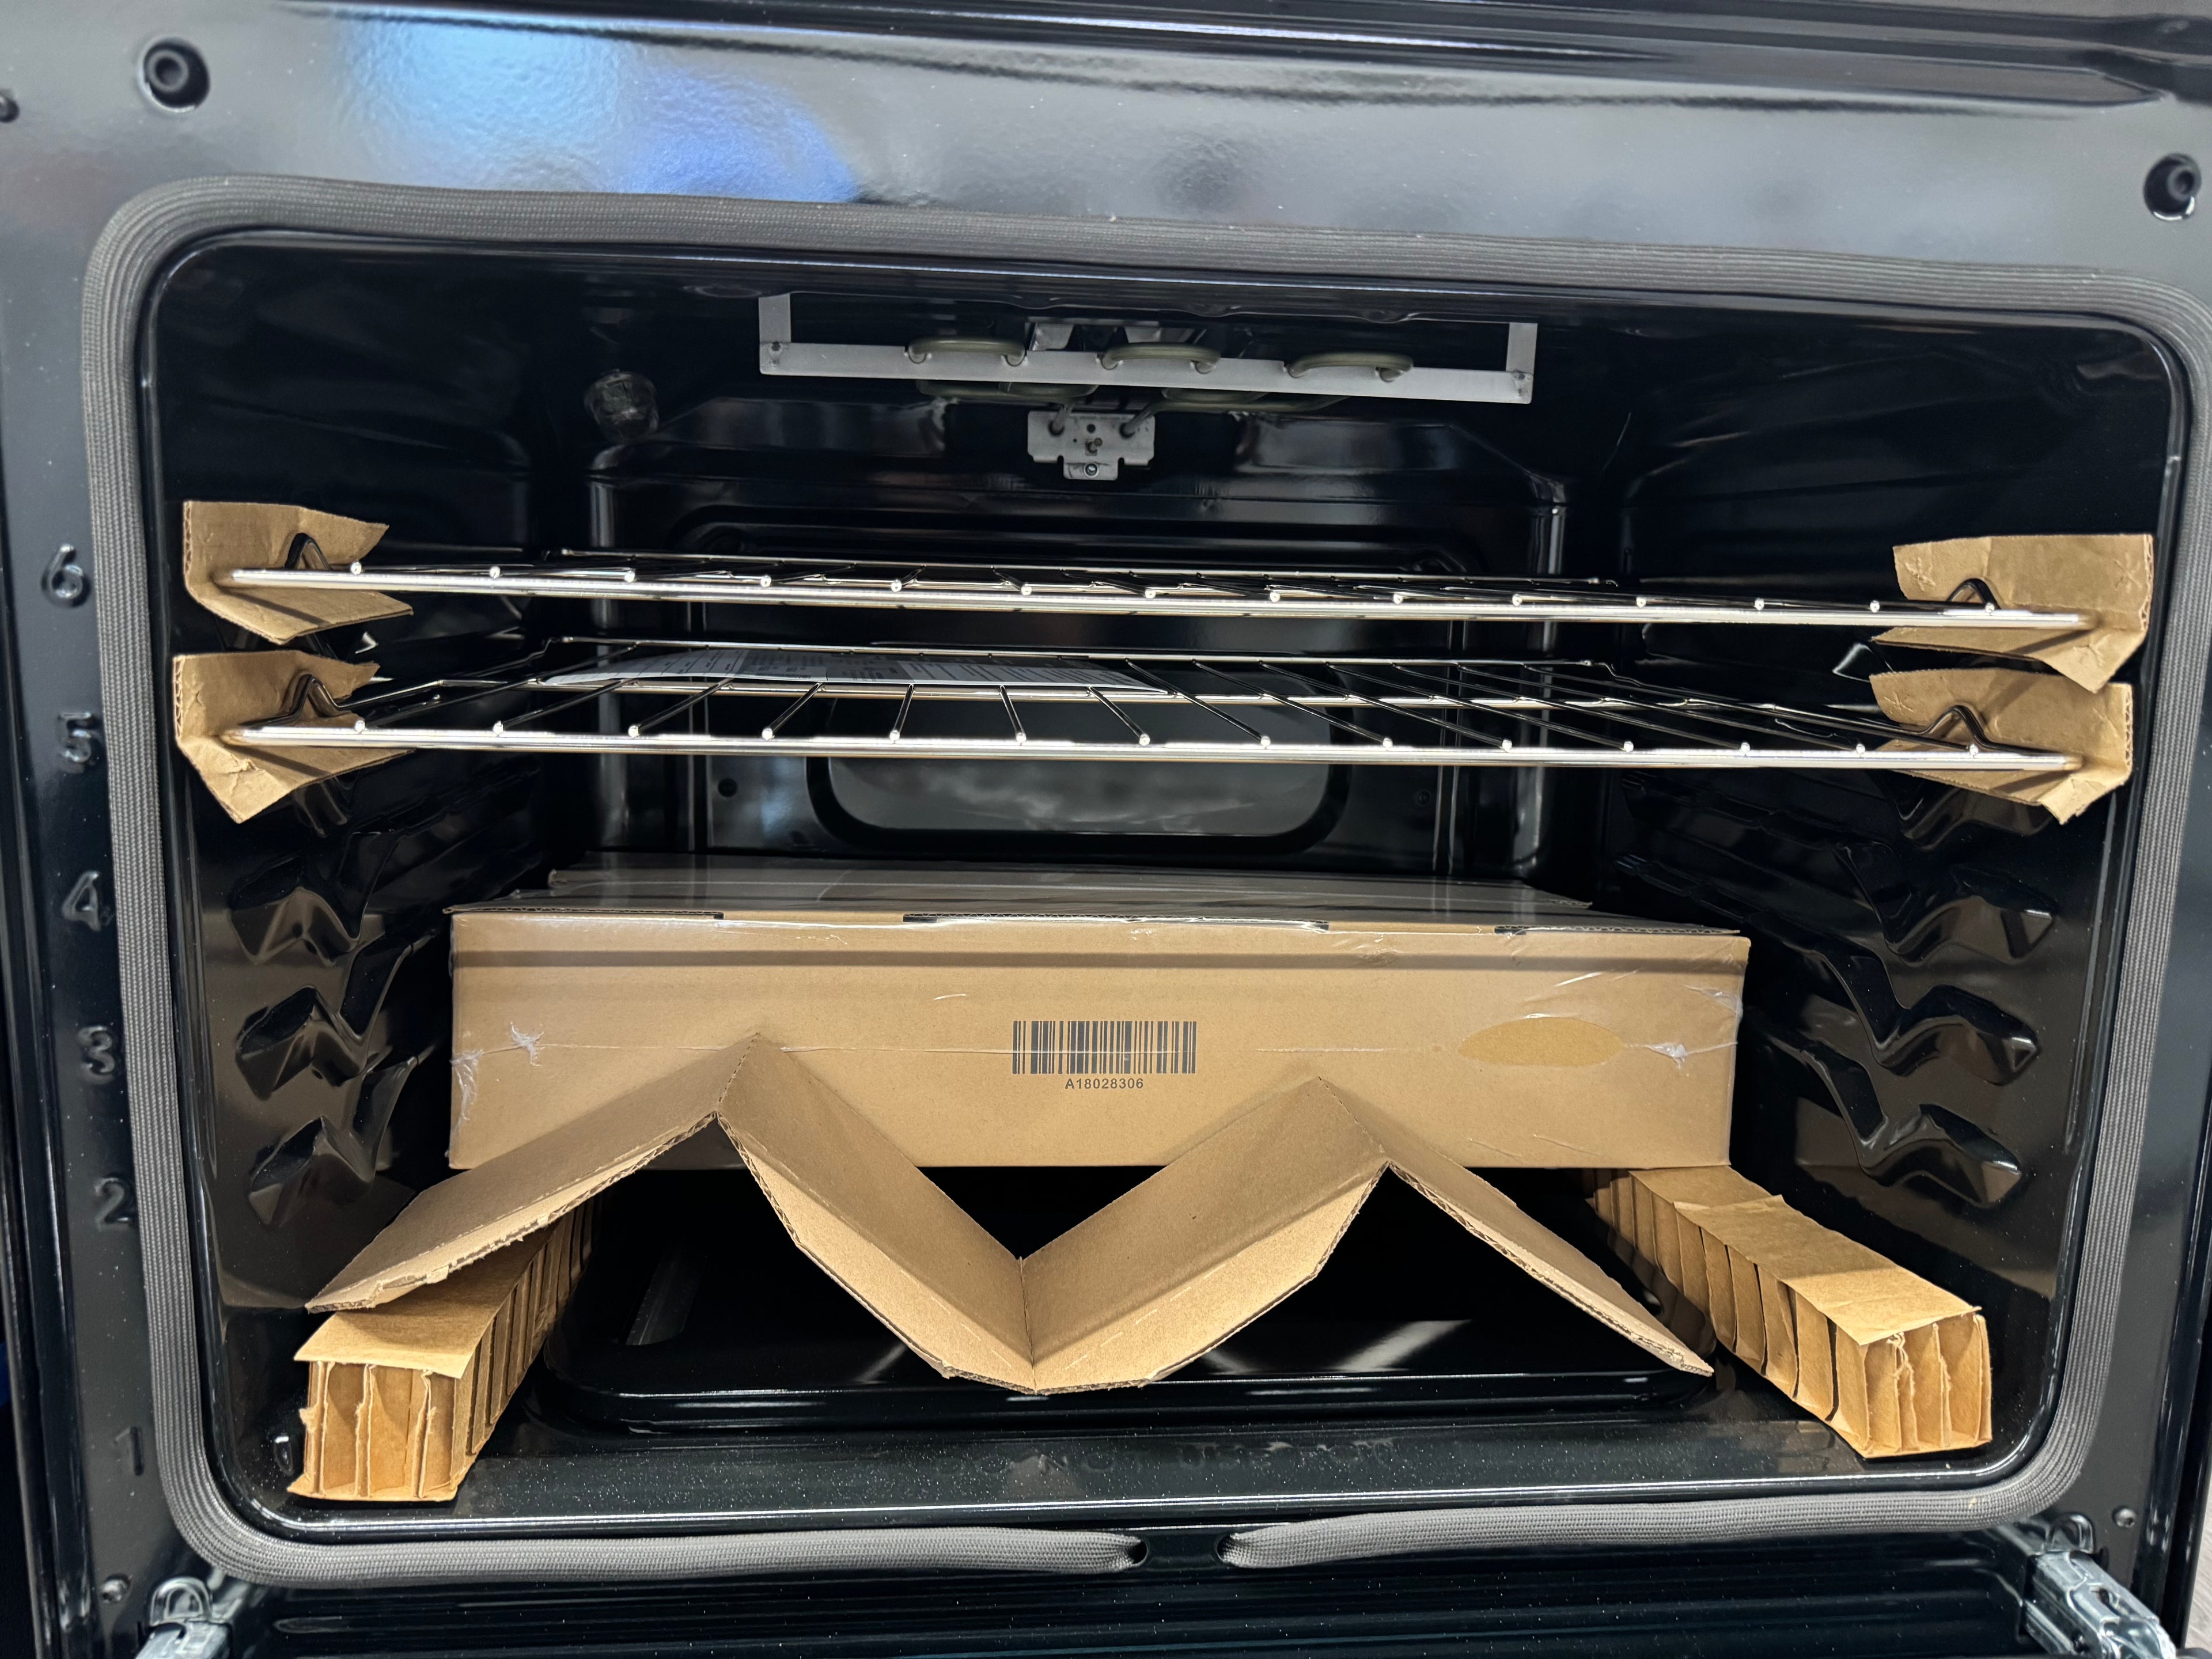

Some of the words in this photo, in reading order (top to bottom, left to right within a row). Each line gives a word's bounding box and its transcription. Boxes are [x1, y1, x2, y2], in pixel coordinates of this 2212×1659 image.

[43, 544, 90, 607] 6
[58, 711, 98, 773] 5
[62, 870, 101, 931] 4
[78, 1025, 116, 1084] 3
[1065, 1078, 1143, 1089] A18028306
[94, 1177, 134, 1230] 2
[116, 1426, 144, 1475] 1
